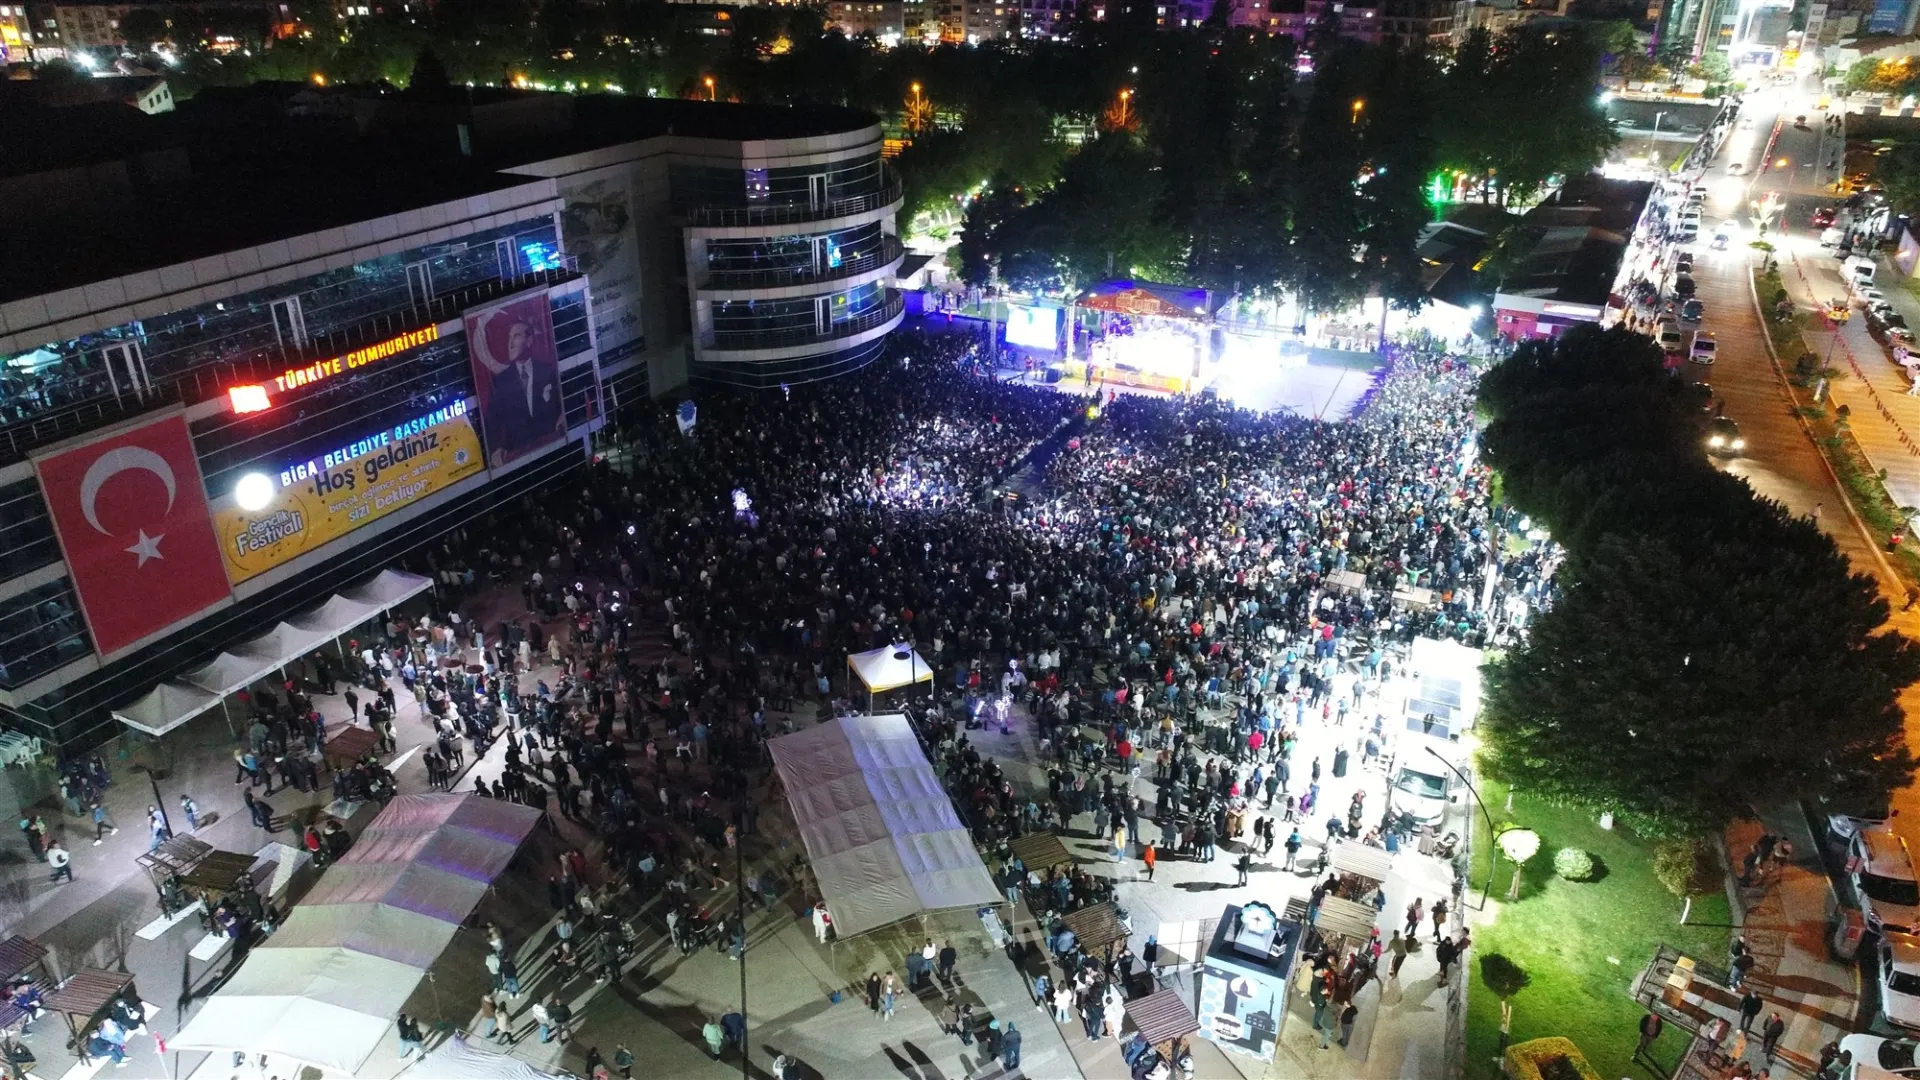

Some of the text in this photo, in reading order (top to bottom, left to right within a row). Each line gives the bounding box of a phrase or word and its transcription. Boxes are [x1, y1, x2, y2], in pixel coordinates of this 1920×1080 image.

[276, 323, 439, 392] TÜRKİYE CUMHURİYETİ
[281, 399, 466, 487] BİGA BELEDİYE BAŞKANLIĞI
[314, 431, 439, 497] Hoş geldiniz
[236, 511, 303, 556] Festivali
[349, 479, 428, 522] sizi bekliyor
